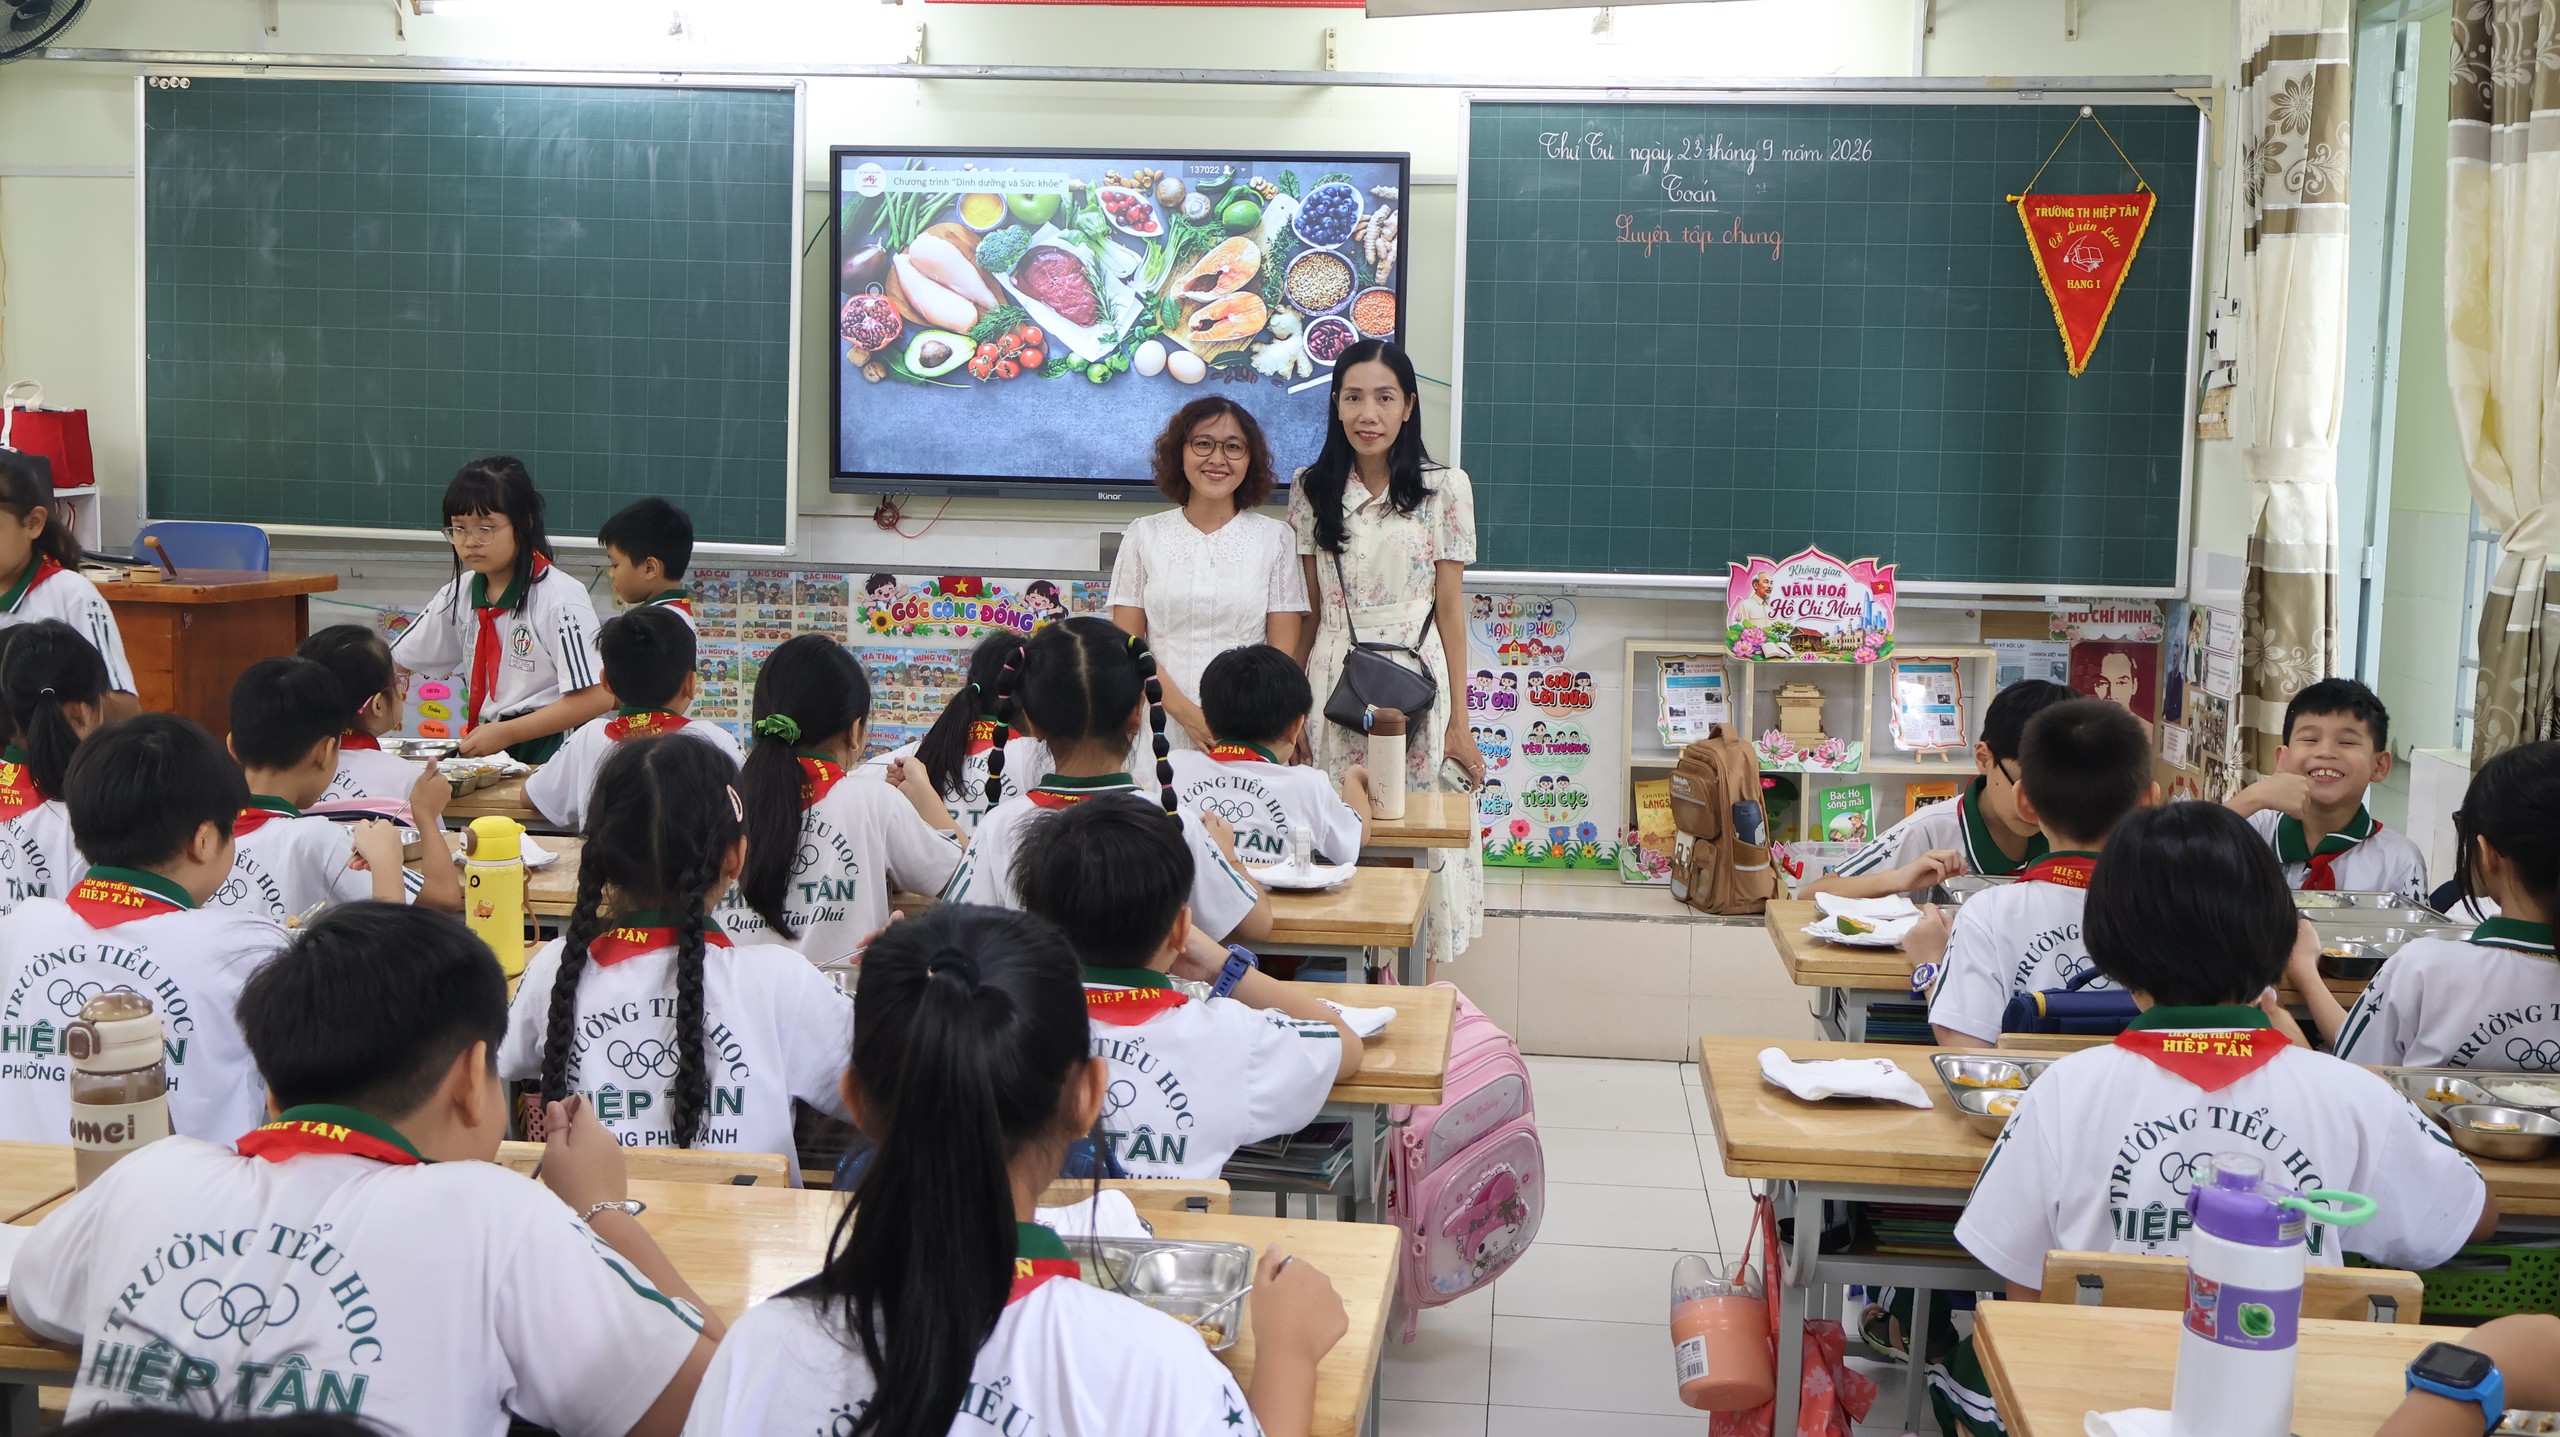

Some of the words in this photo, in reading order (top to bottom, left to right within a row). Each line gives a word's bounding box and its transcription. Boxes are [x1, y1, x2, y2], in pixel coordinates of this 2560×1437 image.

[1630, 144, 1673, 175] ngày
[1677, 138, 1702, 160] 23
[1706, 134, 1757, 175] tháng
[1763, 139, 1774, 161] 9
[1781, 143, 1823, 161] năm
[1830, 139, 1872, 161] 2026
[894, 177, 927, 188] Chương
[929, 178, 949, 186] trình
[978, 178, 1006, 188] dưỡng
[1008, 179, 1018, 187] và
[1020, 178, 1036, 188] Sức
[1190, 166, 1220, 174] 137022
[1661, 174, 1718, 203] Toán
[2035, 205, 2074, 218] TRƯỜNG
[2077, 208, 2090, 218] TH
[2092, 205, 2117, 220] HIỆP
[2120, 206, 2140, 217] TÂN
[1616, 214, 1672, 258] Luyện
[1723, 217, 1784, 261] chung
[2067, 220, 2098, 235] Luân
[2101, 227, 2121, 248] Lưu
[2067, 279, 2094, 291] HẠNG
[2097, 280, 2101, 289] I
[1788, 564, 1821, 578] Không
[1822, 566, 1842, 579] gian
[1782, 583, 1813, 597] VĂN
[1817, 583, 1847, 598] HOÁ
[891, 596, 929, 622] GÓC
[932, 597, 977, 622] CỘNG
[980, 599, 1034, 632] ĐỒNG
[1498, 599, 1525, 619] LỚP
[1525, 602, 1553, 621] HỌC
[1768, 599, 1795, 618] Hồ
[1798, 599, 1822, 616] Chí
[1825, 601, 1862, 618] Minh
[2091, 606, 2115, 623] CHÍ
[2117, 609, 2152, 623] MINH
[1485, 621, 1525, 642] HẠNH
[1525, 619, 1565, 638] PHÚC
[1545, 671, 1573, 690] GIỮ
[1467, 684, 1488, 709] ẾT
[1491, 691, 1517, 710] ƠN
[1530, 688, 1556, 707] LỜI
[1521, 741, 1544, 755] YÊU
[1545, 741, 1591, 755] THƯƠNG
[332, 769, 356, 791] ỂU
[1000, 772, 1018, 797] HỌ
[1181, 776, 1227, 806] ƯỜNG
[1231, 776, 1270, 800] TIỂU
[1265, 798, 1289, 835] HỌC
[1483, 794, 1513, 816] KẾT
[1521, 790, 1556, 808] TÍCH
[1557, 790, 1589, 810] CỰC
[831, 832, 860, 878] HỌC
[1233, 828, 1285, 856] TÂN
[20, 838, 51, 880] HỌC
[234, 847, 261, 876] ỂU
[256, 872, 286, 917] HỌC
[797, 874, 857, 904] TÂN
[111, 892, 146, 908] TÂN
[810, 905, 845, 926] Phú
[2014, 923, 2080, 987] TRƯỜNG
[4, 944, 87, 1021] TRƯỜNG
[97, 944, 161, 981] TIỂU
[154, 977, 195, 1034] HỌC
[566, 1001, 641, 1087] TRƯỜNG
[708, 1022, 751, 1082] HỌC
[2213, 1040, 2254, 1058] TÂN
[2446, 1004, 2543, 1068] TRƯỜNG
[1092, 1036, 1160, 1075] TIỂU
[1155, 1069, 1195, 1130] HỌC
[1104, 1123, 1189, 1165] TÂN
[2108, 1106, 2198, 1204] TRƯỜNG
[2207, 1105, 2289, 1152] TIỂU
[2281, 1147, 2327, 1200] HỌ
[265, 1222, 345, 1278] TỂU
[329, 1269, 383, 1367] HỌC
[231, 1353, 370, 1418] TÂN
